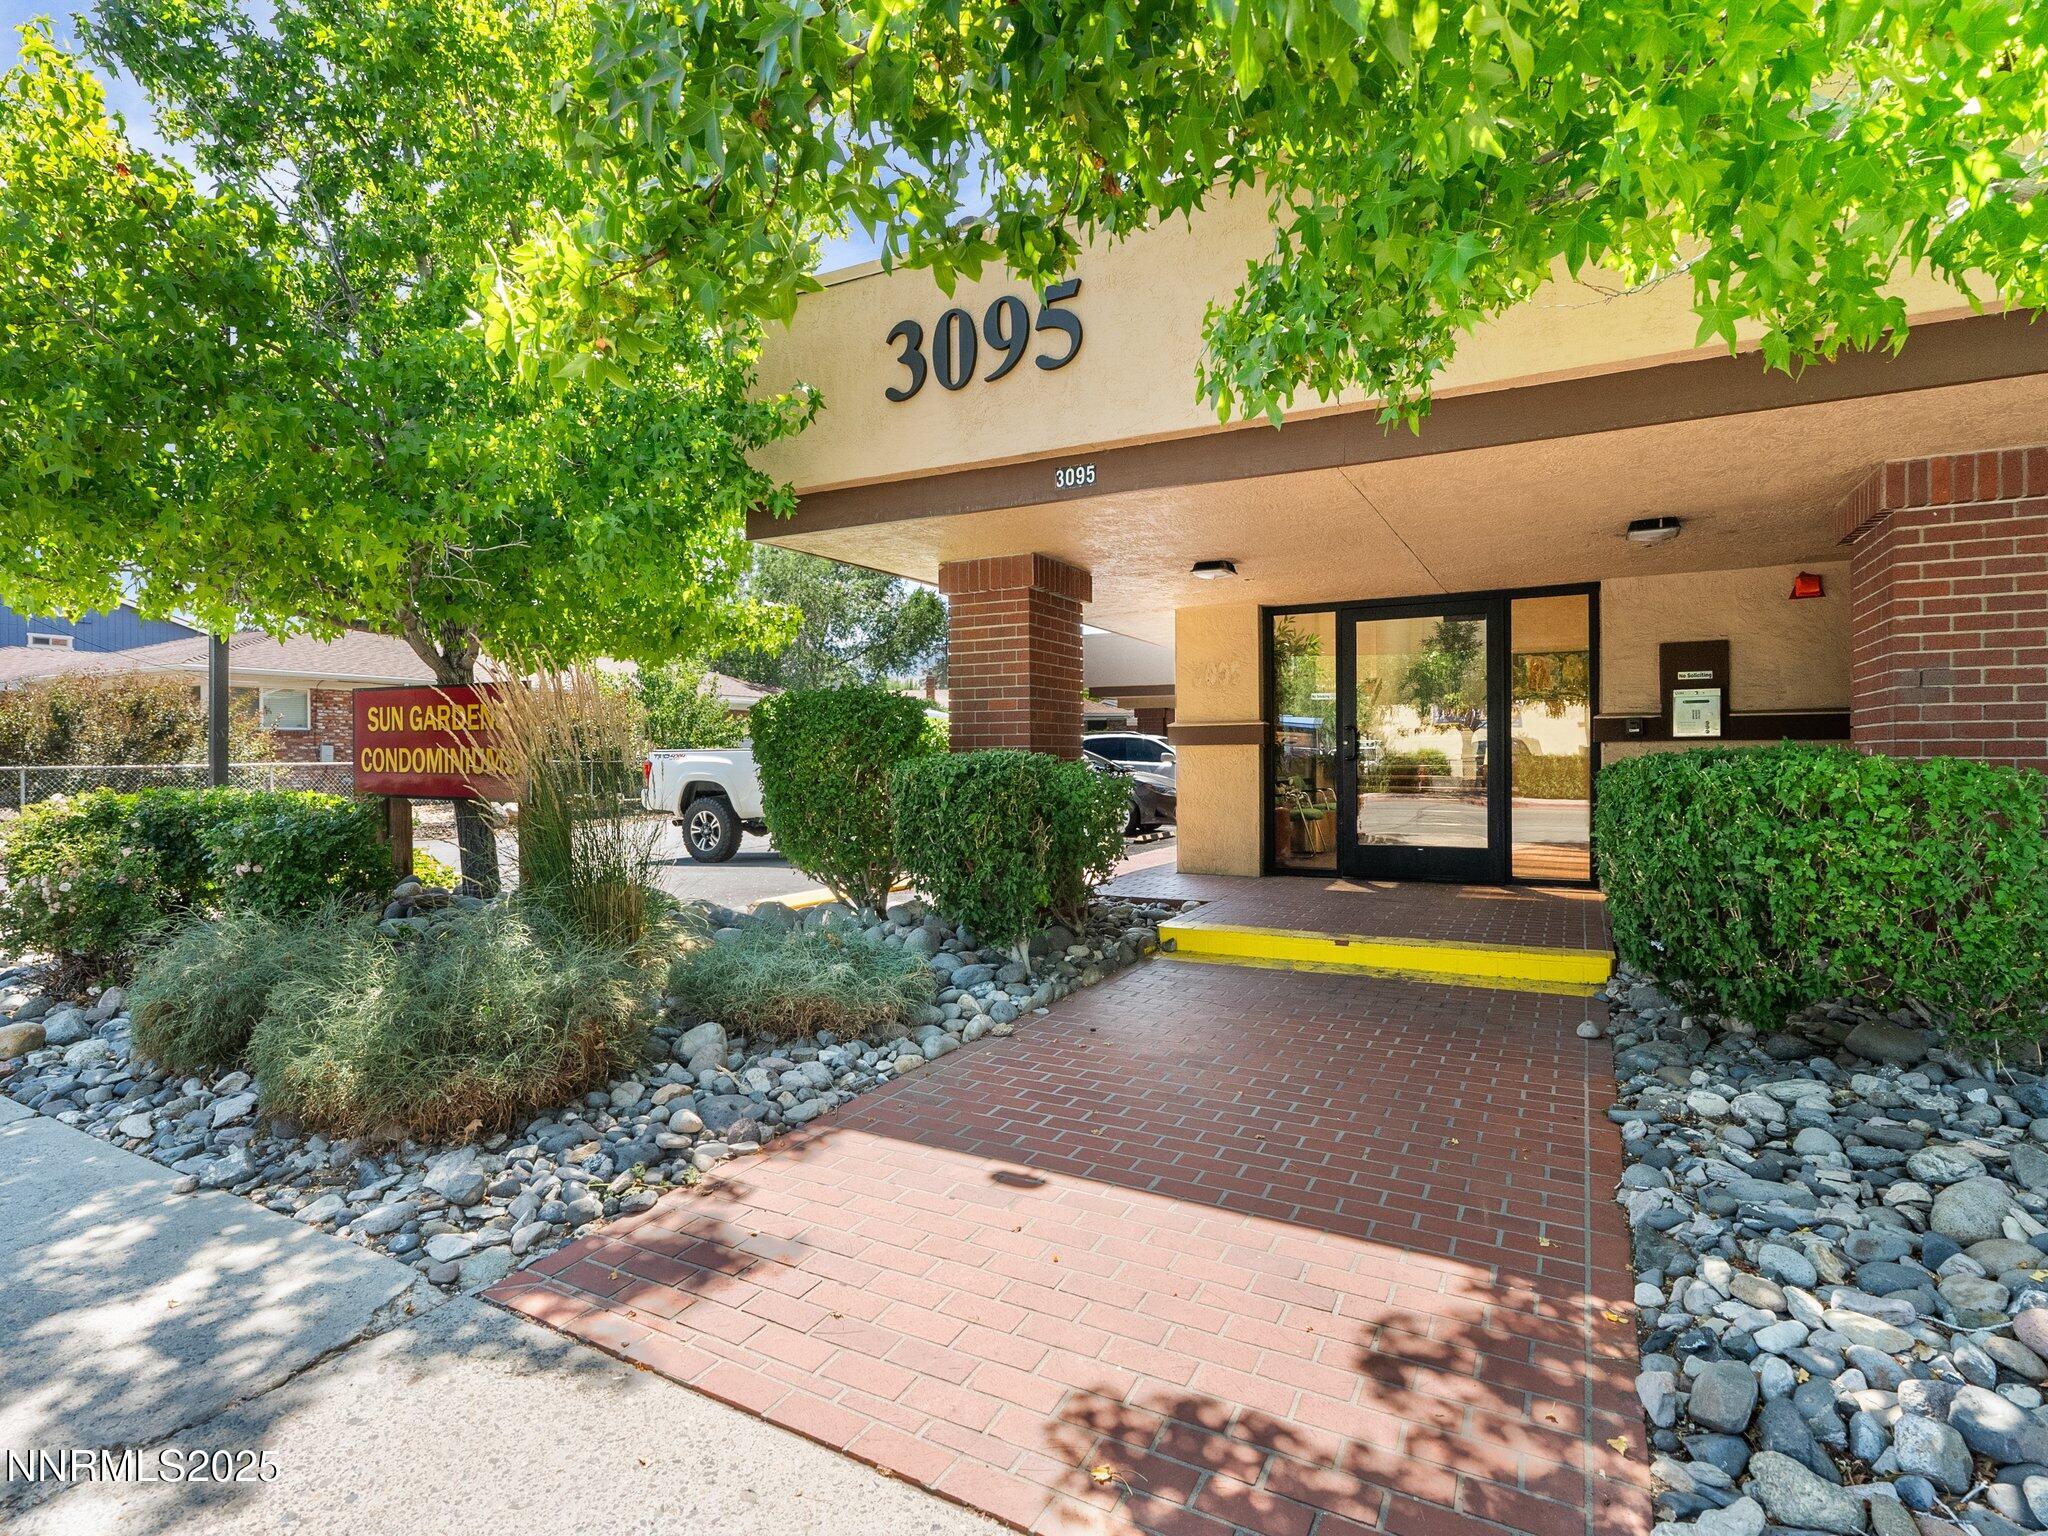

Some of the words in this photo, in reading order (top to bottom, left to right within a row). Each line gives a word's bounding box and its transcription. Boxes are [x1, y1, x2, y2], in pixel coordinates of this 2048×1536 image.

[885, 278, 1084, 402] 3095
[1056, 465, 1095, 487] 3095
[367, 706, 404, 732] SUN
